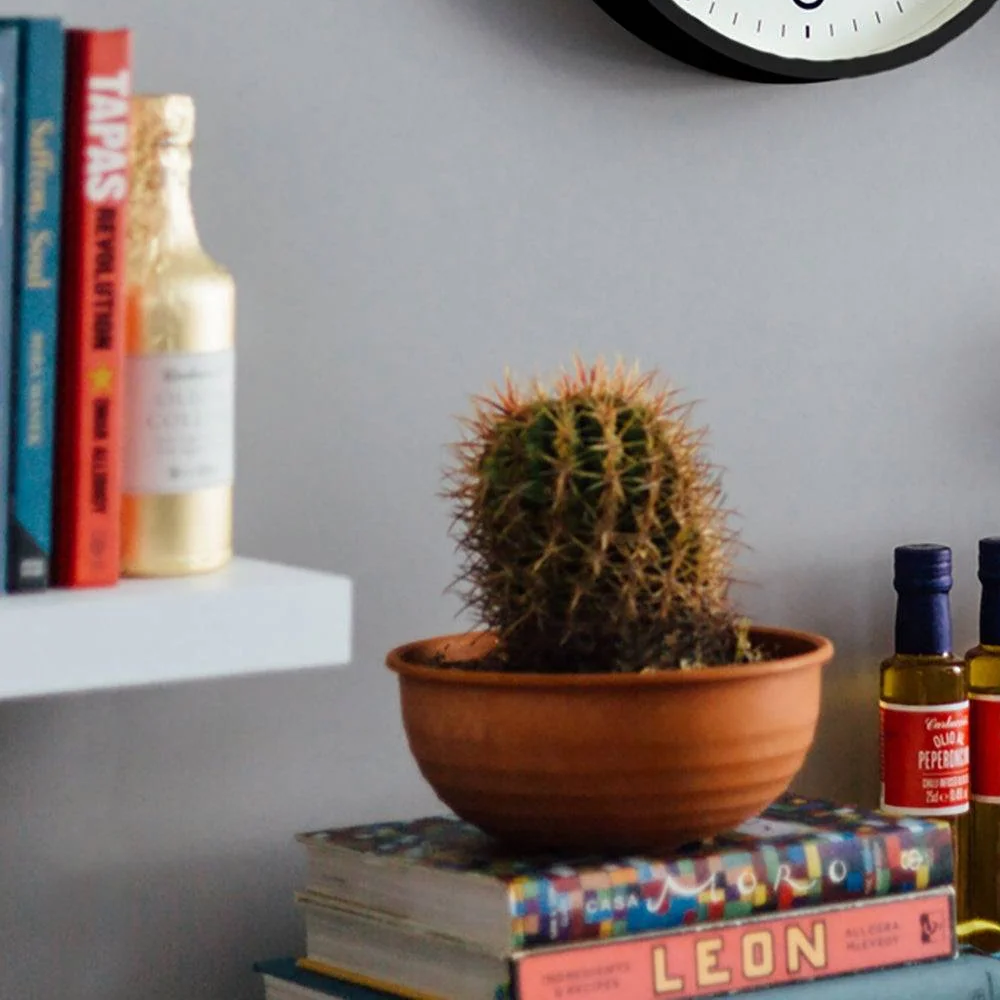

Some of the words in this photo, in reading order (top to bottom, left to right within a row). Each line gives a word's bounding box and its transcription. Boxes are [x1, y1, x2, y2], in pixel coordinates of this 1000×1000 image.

[86, 70, 131, 204] TAPAS
[94, 207, 117, 351] REVOLUTION
[585, 891, 640, 914] CASA
[652, 920, 828, 993] LEON
